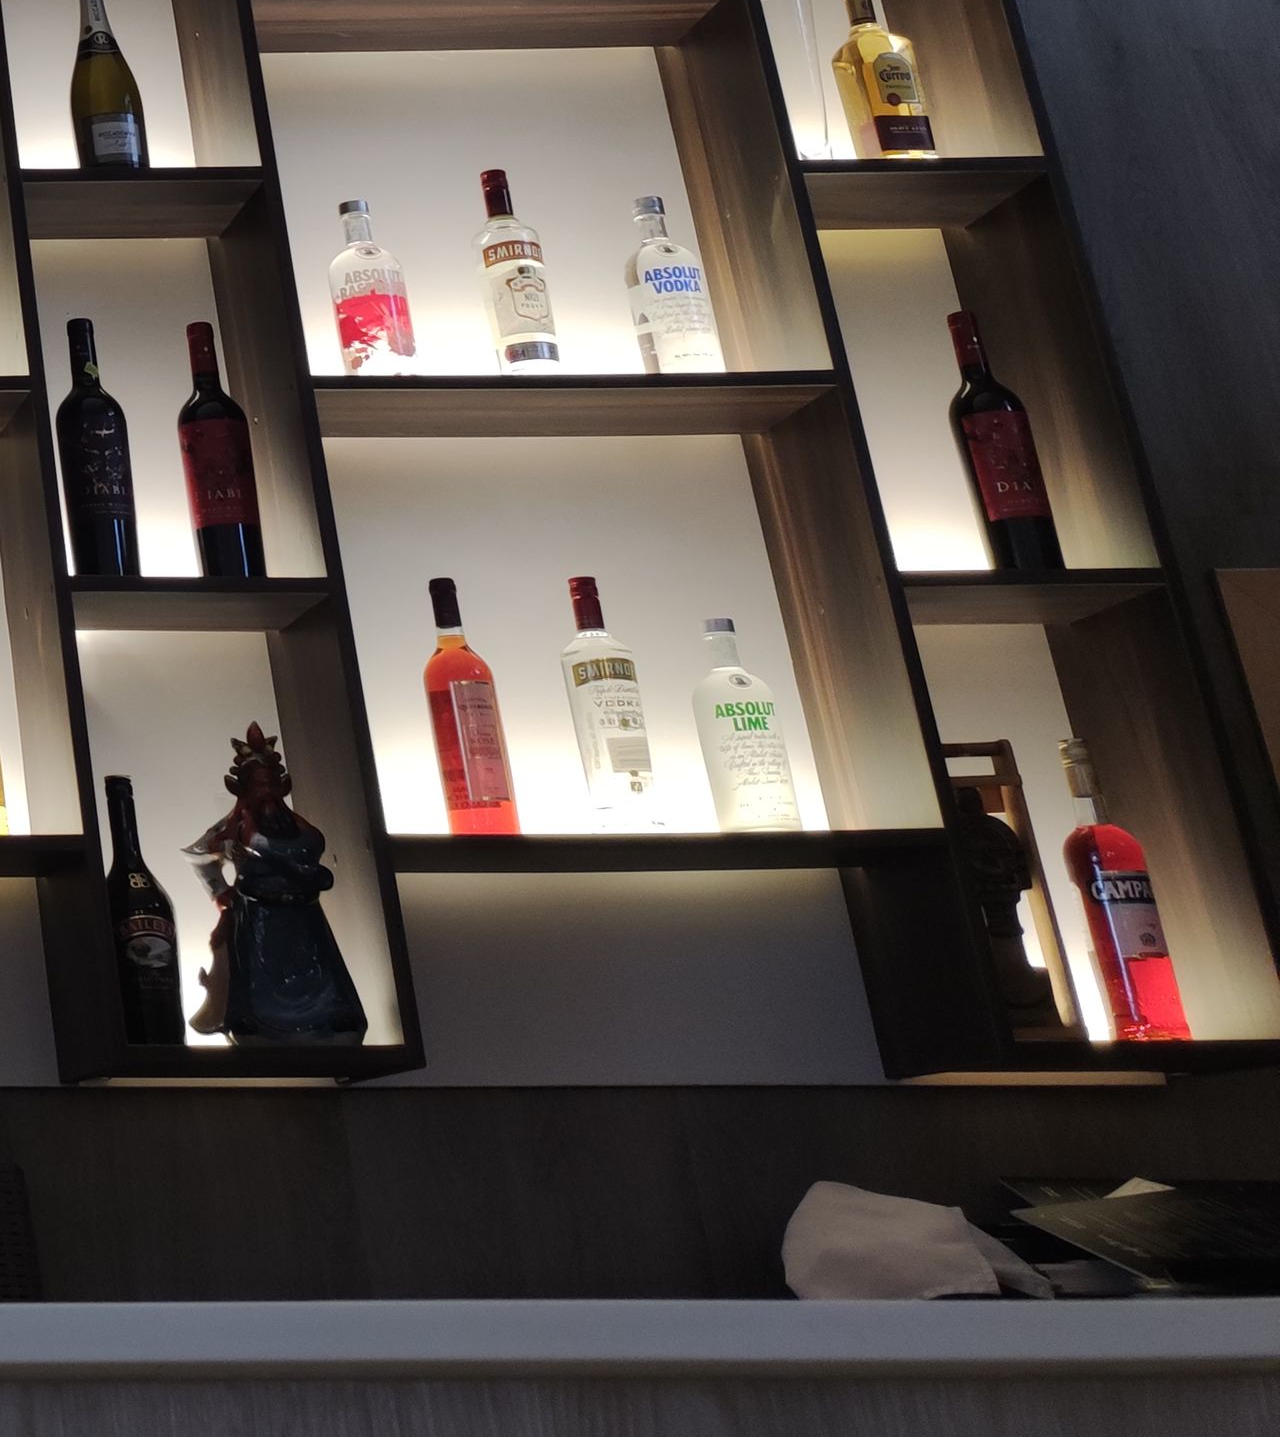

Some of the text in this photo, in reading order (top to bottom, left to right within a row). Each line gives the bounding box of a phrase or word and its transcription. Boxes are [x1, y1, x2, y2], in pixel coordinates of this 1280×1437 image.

[344, 268, 402, 285] ABSOLUT
[644, 266, 700, 283] ABSOLUT
[652, 280, 702, 295] VODKA
[715, 702, 775, 719] ABSOLUT
[733, 716, 769, 731] LIME
[120, 918, 174, 935] BAILEYS
